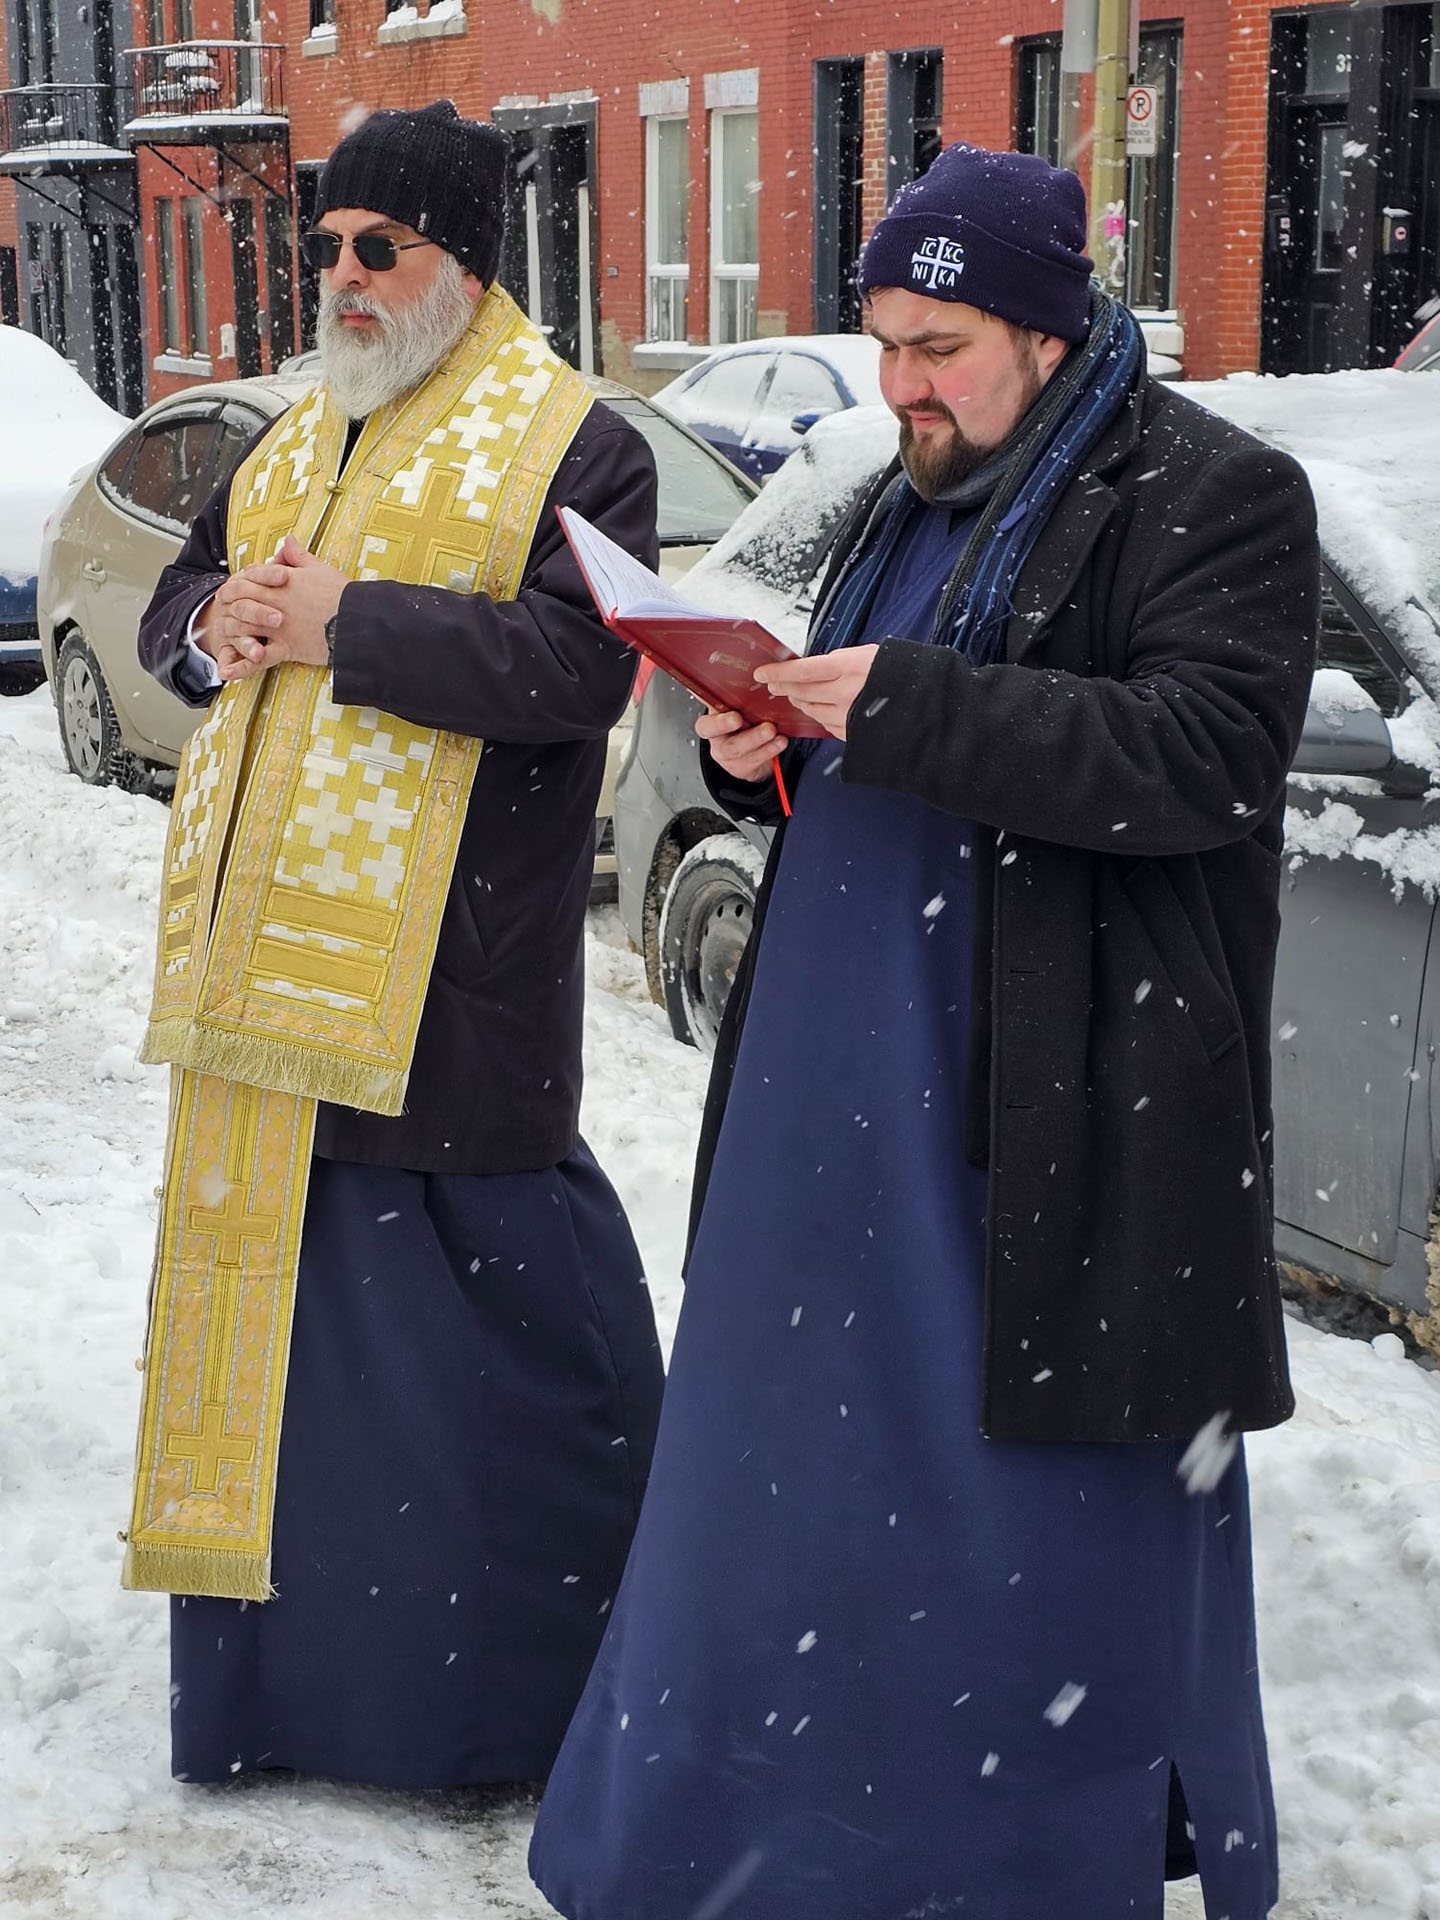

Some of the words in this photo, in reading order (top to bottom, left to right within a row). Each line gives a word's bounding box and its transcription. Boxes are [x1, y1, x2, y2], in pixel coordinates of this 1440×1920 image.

[920, 237, 938, 256] IC
[943, 241, 965, 262] XC
[912, 263, 929, 280] NI
[938, 269, 956, 287] KA
